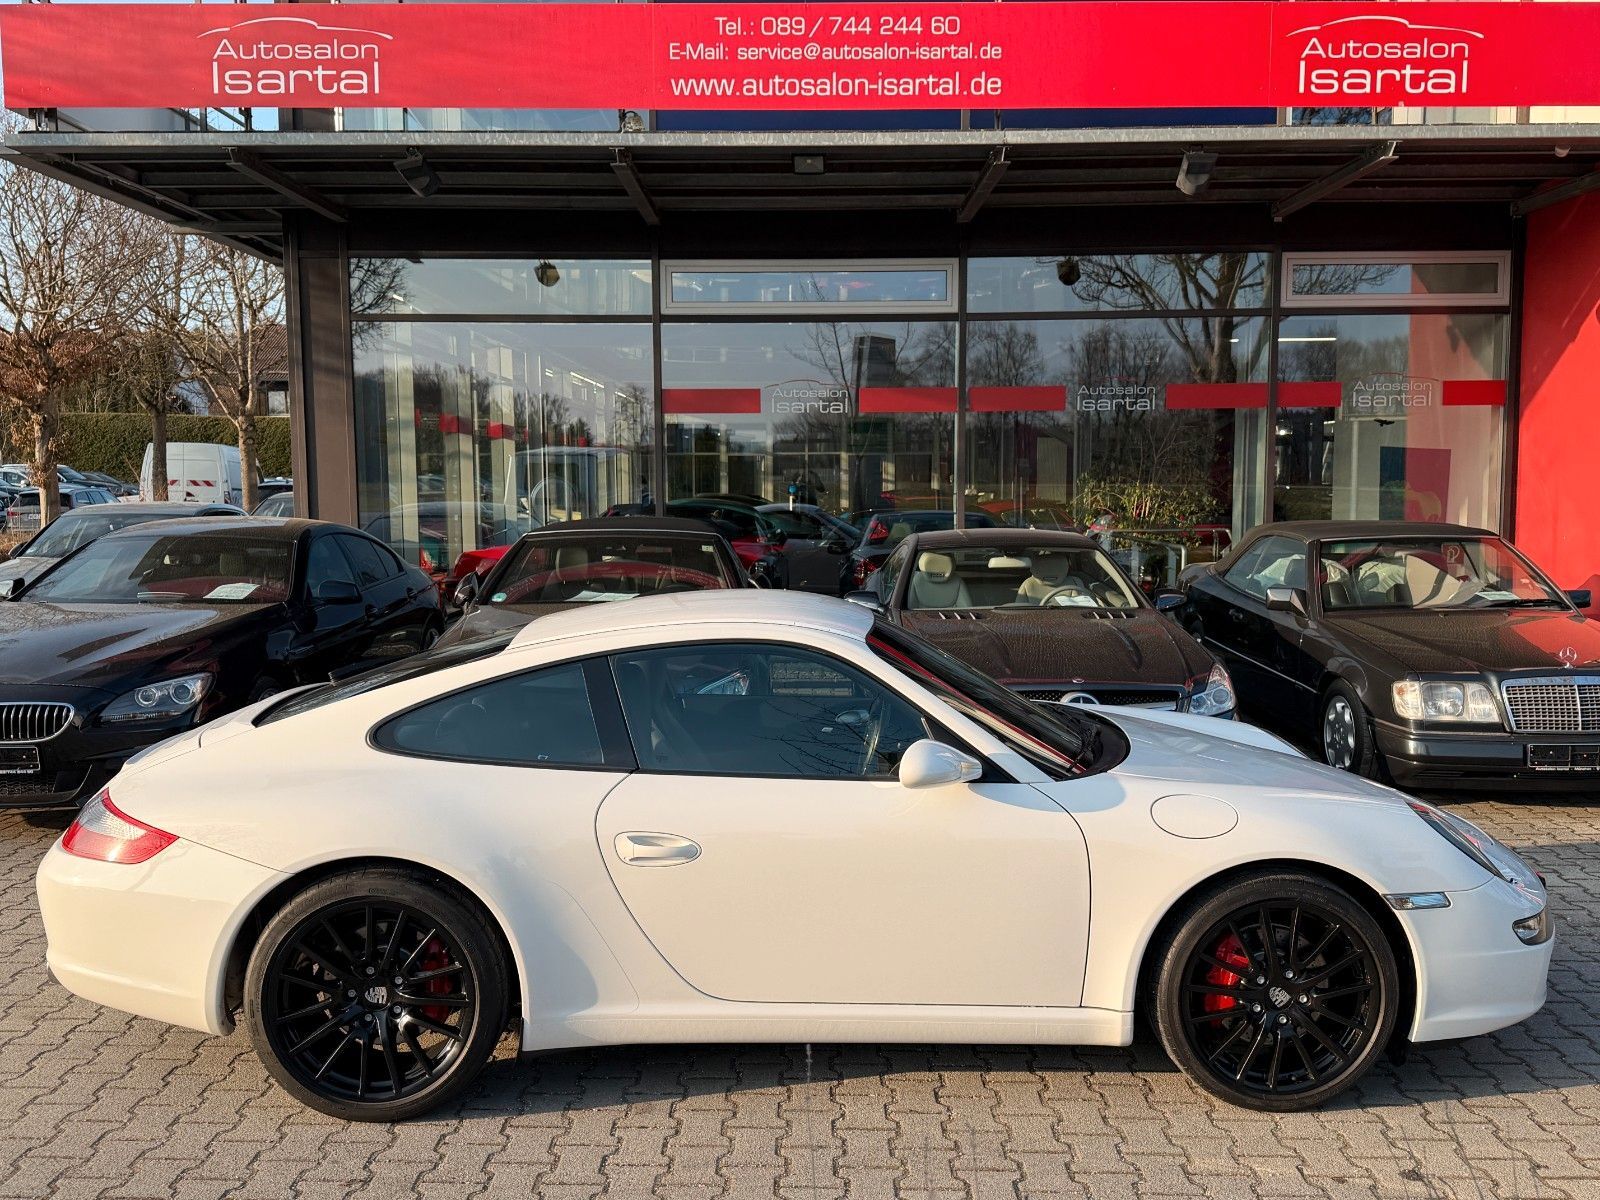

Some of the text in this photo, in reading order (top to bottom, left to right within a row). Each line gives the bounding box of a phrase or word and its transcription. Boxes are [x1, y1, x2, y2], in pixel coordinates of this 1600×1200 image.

[714, 16, 754, 36] Tel.:
[760, 16, 806, 36] 089
[829, 16, 872, 35] 744
[880, 16, 923, 35] 244
[931, 16, 961, 35] 60
[213, 38, 380, 60] Autosalon
[669, 42, 1002, 60] E-Mail: service@autosalon-isartal.de
[1301, 37, 1469, 59] Autosalon
[213, 61, 380, 95] Isartal
[670, 71, 1002, 96] www.autosalon-isartal.de
[1298, 60, 1468, 94] Isartal
[772, 388, 849, 398] Autosalon
[1077, 384, 1156, 395] Autosalon
[1353, 381, 1432, 391] Autosalon
[771, 398, 848, 414] Isartal
[1076, 394, 1156, 411] Isartal
[1352, 391, 1432, 407] Isartal
